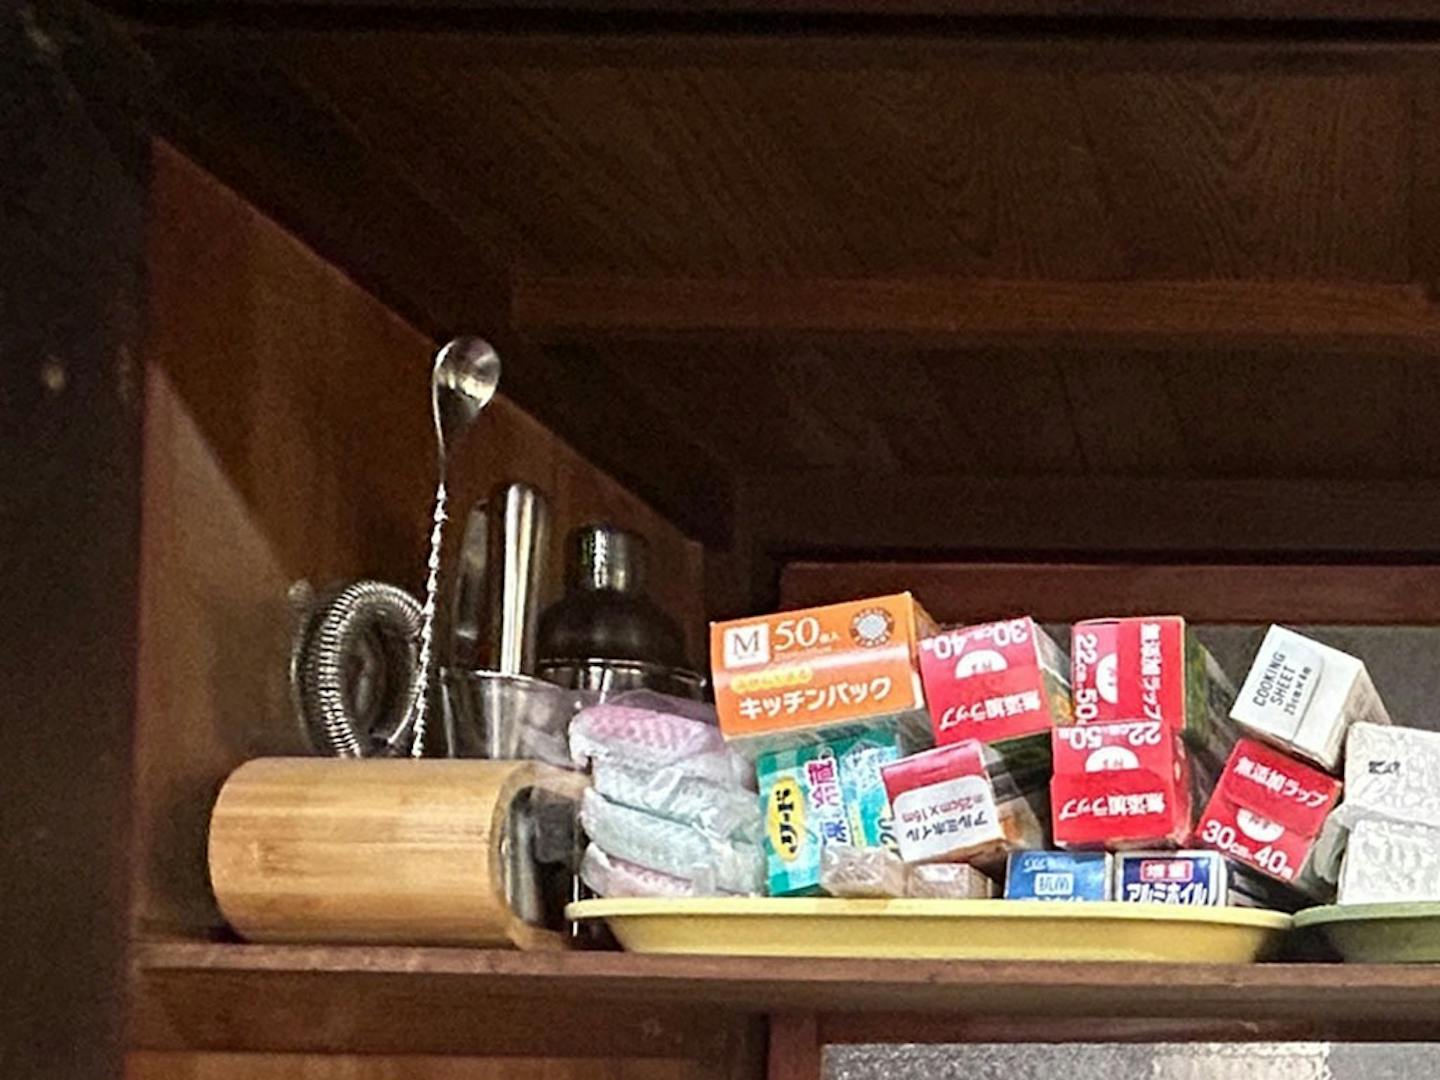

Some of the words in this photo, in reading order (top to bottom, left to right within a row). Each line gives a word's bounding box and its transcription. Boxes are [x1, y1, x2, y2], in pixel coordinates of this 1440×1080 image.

[733, 629, 759, 653] M
[738, 676, 892, 720] キッチンパック
[1252, 651, 1287, 707] COOKING
[1271, 666, 1296, 706] SHEET
[775, 787, 798, 853] リード
[904, 816, 989, 842] アルミホイル
